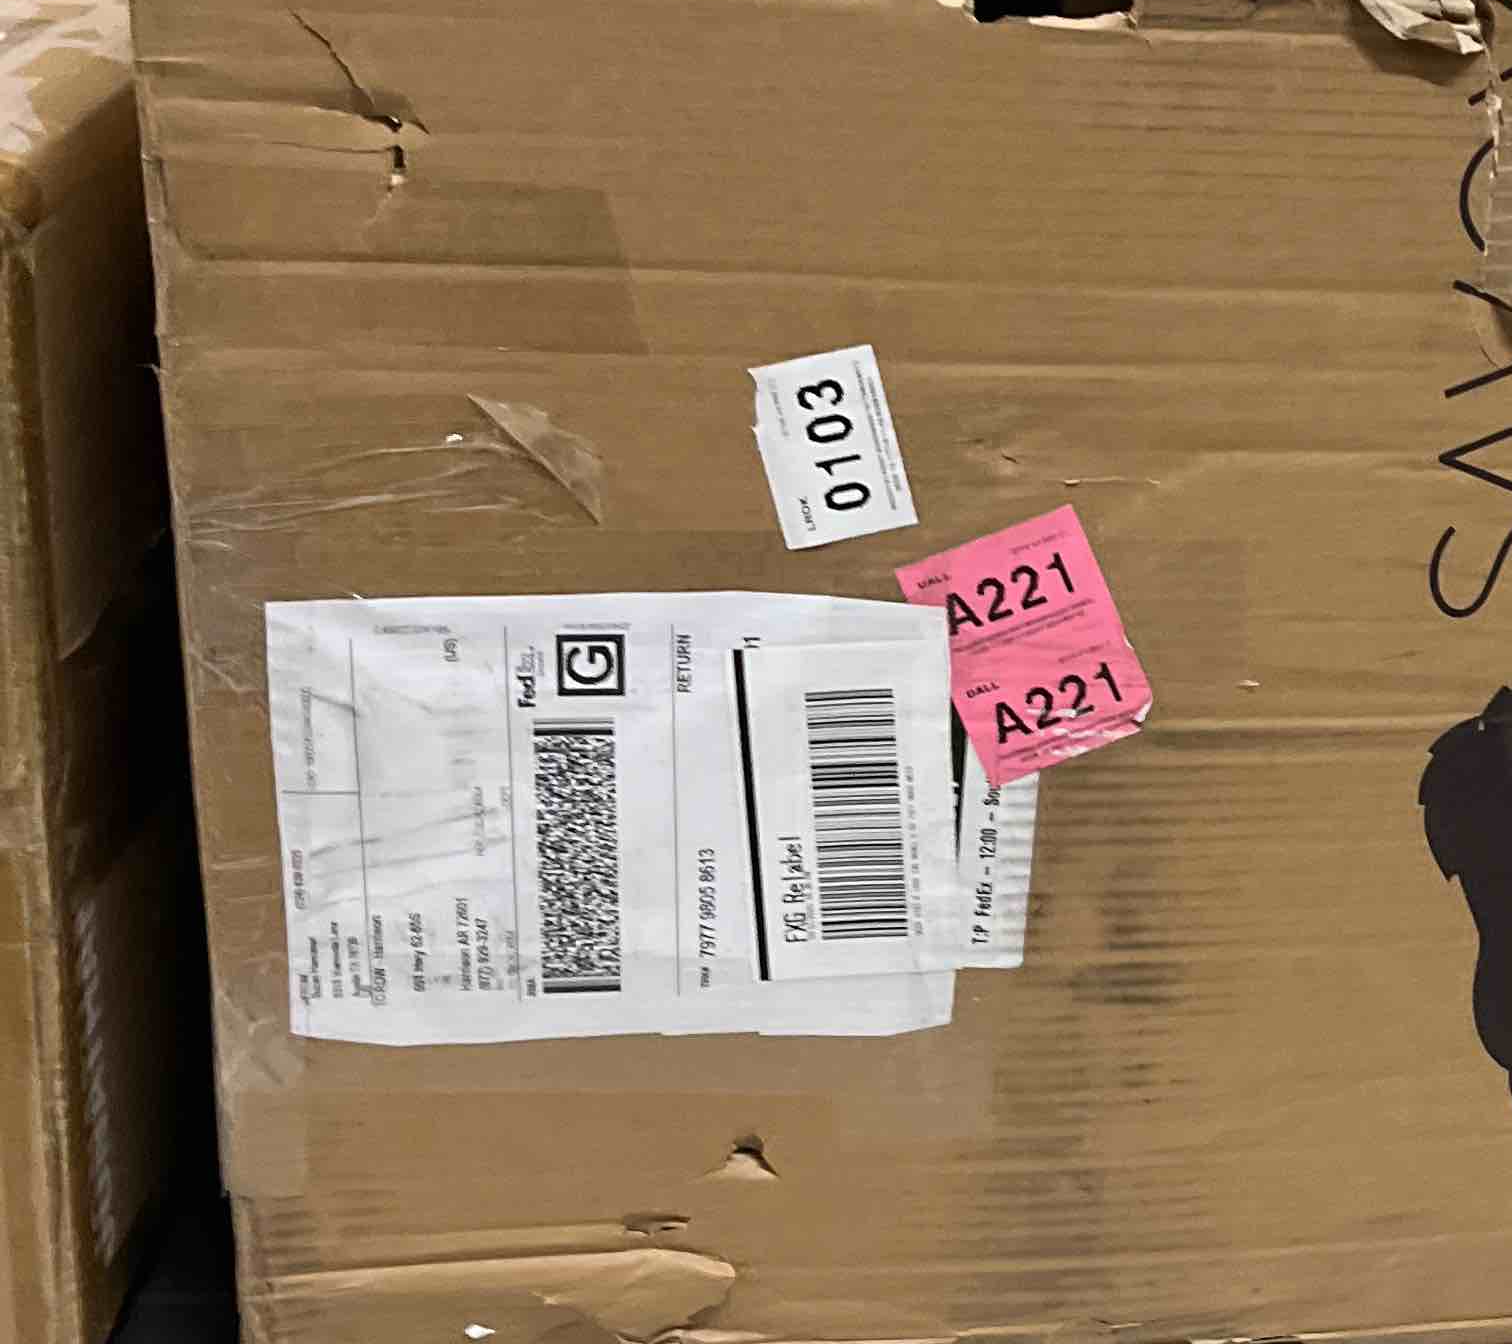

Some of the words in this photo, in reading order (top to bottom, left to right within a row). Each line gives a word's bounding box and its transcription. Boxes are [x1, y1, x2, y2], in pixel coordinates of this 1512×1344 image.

[796, 378, 871, 512] 0103
[946, 551, 1075, 637] A221
[565, 645, 615, 686] G
[675, 634, 692, 693] RETURN
[995, 661, 1123, 745] A221
[979, 828, 998, 859] 12:00
[778, 836, 805, 904] Relabel
[974, 882, 993, 917] FedEx
[698, 923, 717, 958] 7977
[782, 912, 808, 944] FXG
